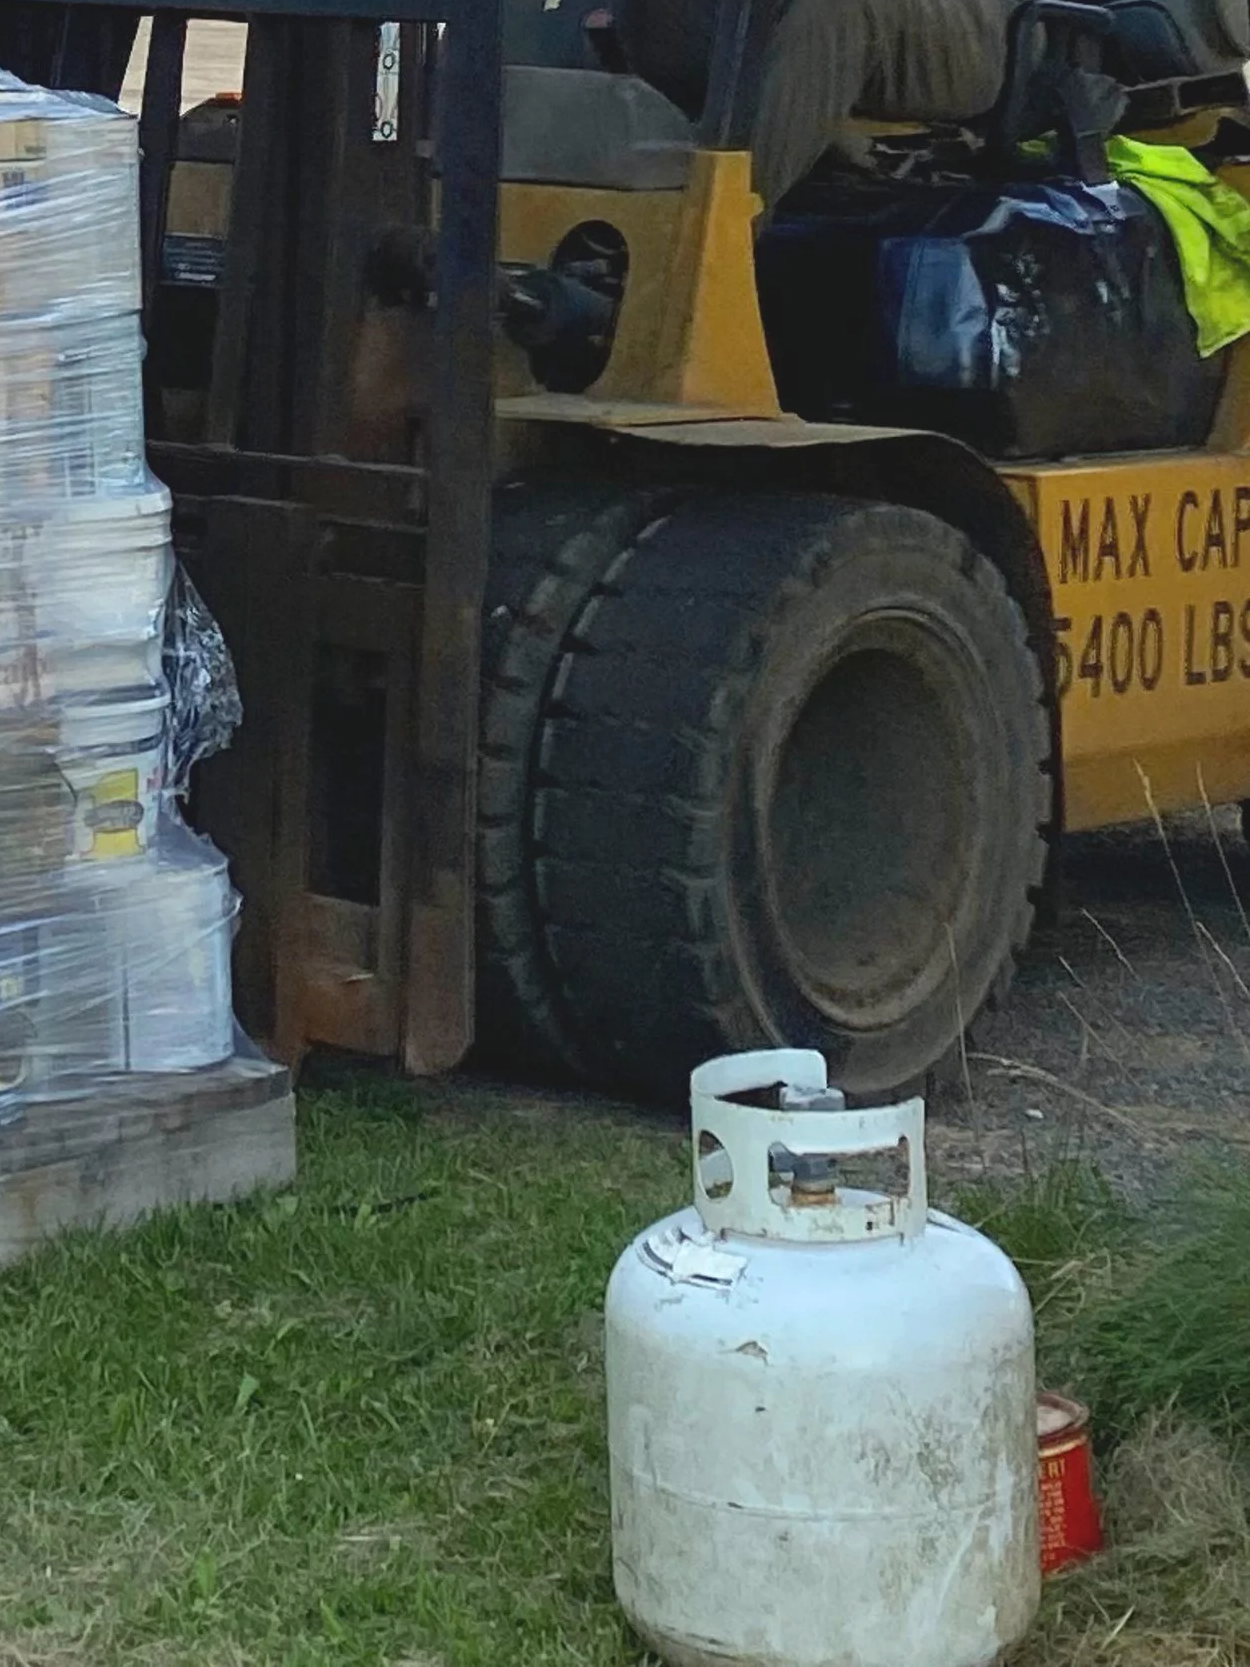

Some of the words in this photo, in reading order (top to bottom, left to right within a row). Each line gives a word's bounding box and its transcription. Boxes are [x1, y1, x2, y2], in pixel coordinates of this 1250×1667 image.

[1058, 493, 1152, 584] MAX
[1175, 486, 1250, 572] CAP
[1053, 608, 1163, 698] 5400
